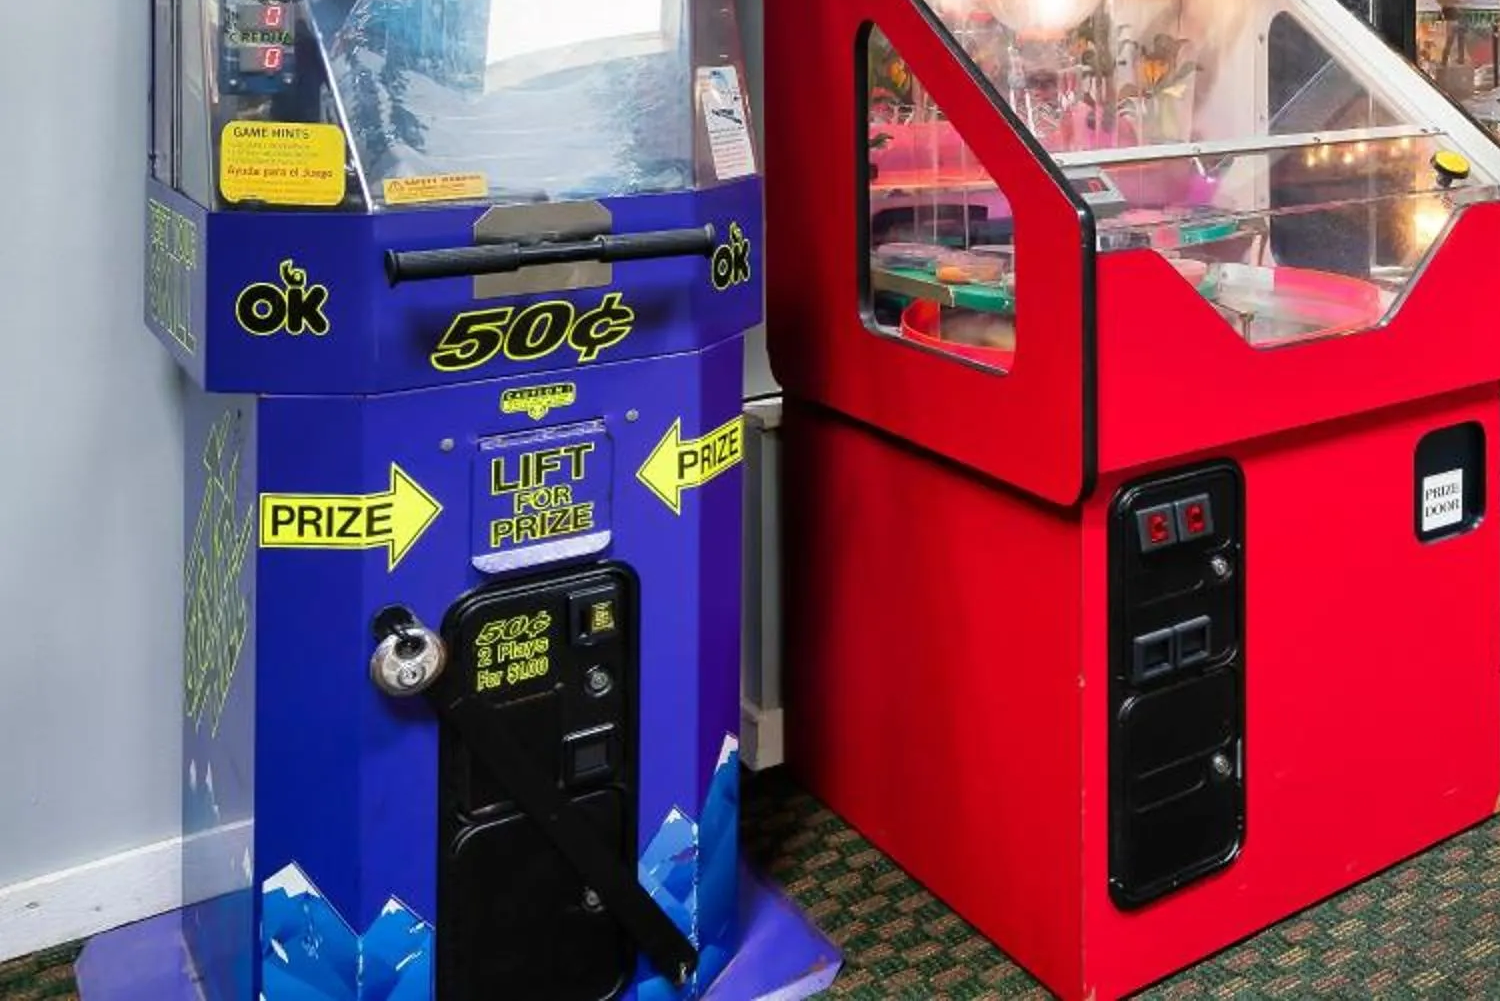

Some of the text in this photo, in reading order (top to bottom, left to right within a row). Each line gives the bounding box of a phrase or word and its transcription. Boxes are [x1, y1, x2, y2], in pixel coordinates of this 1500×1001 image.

[233, 126, 269, 138] GAME
[430, 293, 636, 372] 50¢
[677, 418, 742, 484] PRIZE
[491, 442, 595, 496] LIFT
[513, 484, 573, 512] FOR
[1425, 483, 1460, 501] PRIZE
[270, 502, 395, 540] PRIZE
[1425, 499, 1460, 517] DOOR
[489, 503, 595, 548] PRIZE
[477, 637, 549, 668] 2 Plays
[476, 668, 503, 691] For
